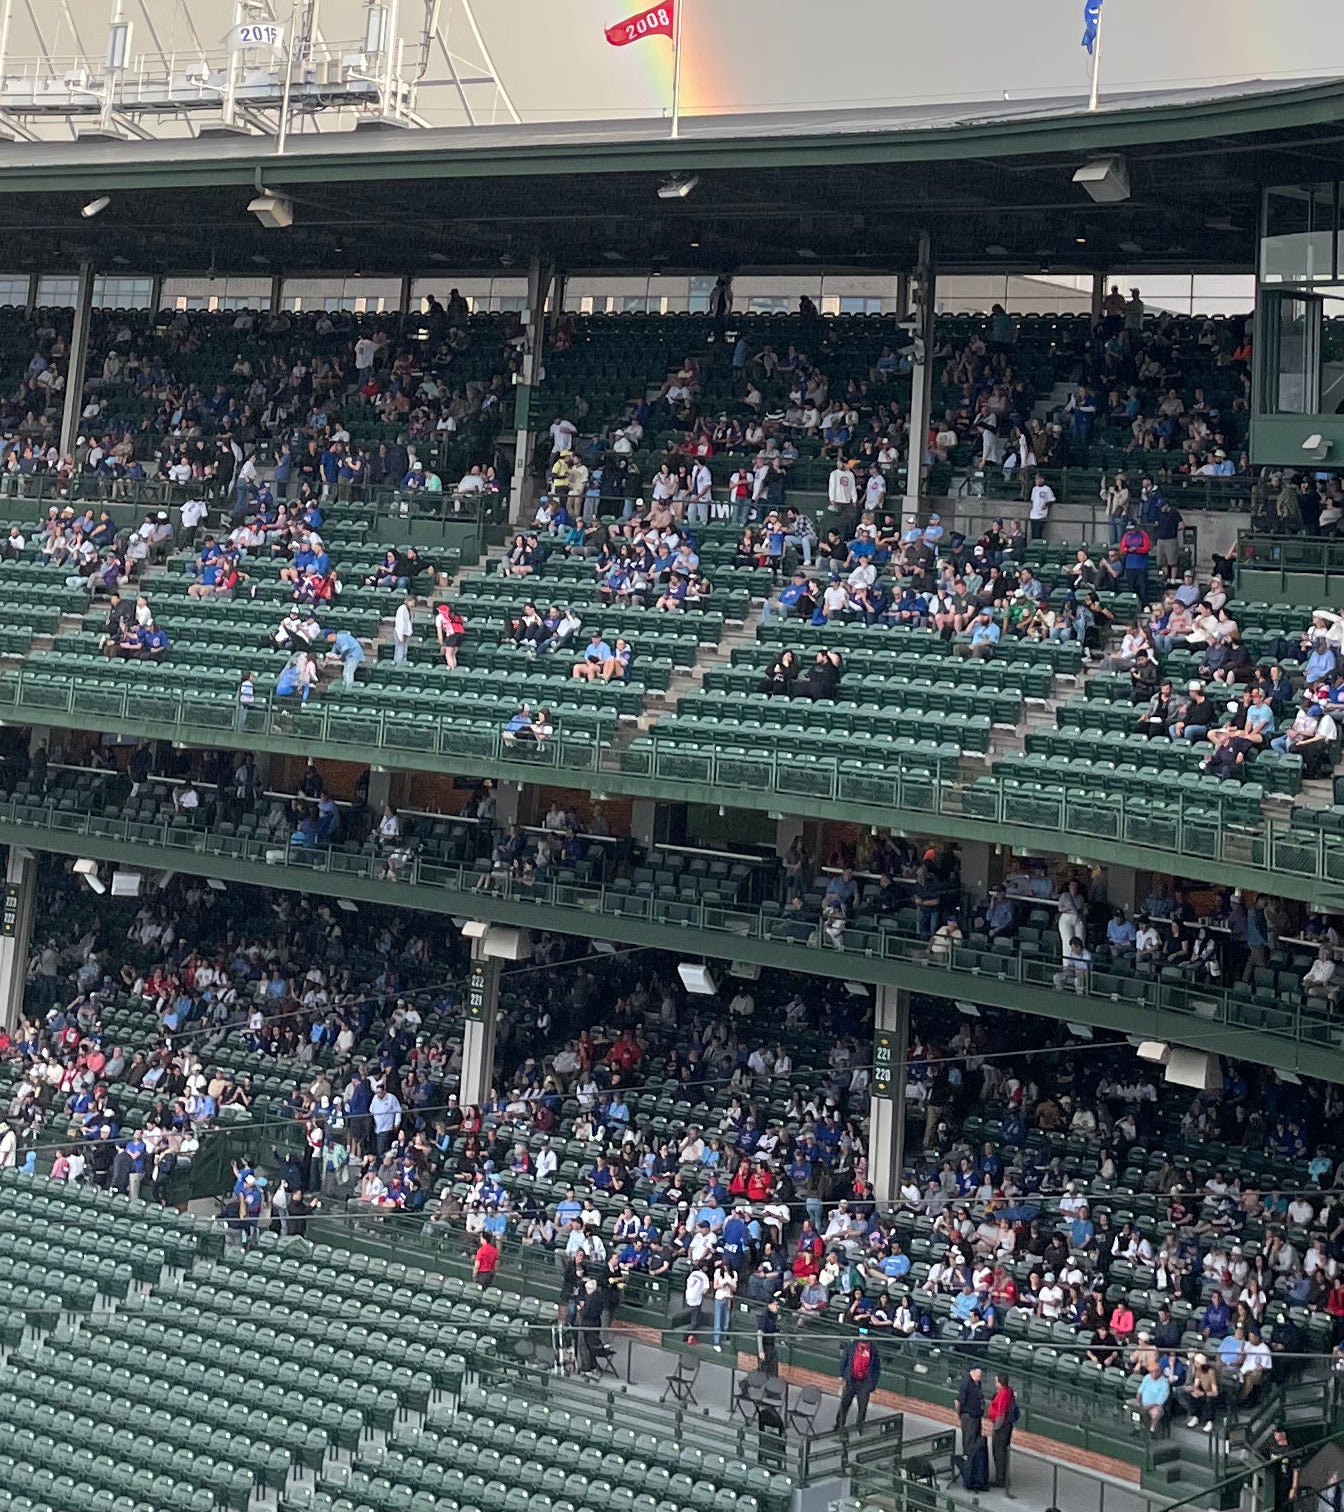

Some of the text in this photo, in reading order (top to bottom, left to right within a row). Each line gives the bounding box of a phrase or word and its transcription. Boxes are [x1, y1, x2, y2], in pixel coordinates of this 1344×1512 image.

[626, 8, 669, 40] 2008
[240, 26, 277, 44] 2015
[471, 974, 484, 988] 222
[470, 993, 483, 1006] 221
[877, 1047, 891, 1061] 221
[875, 1067, 891, 1082] 220
